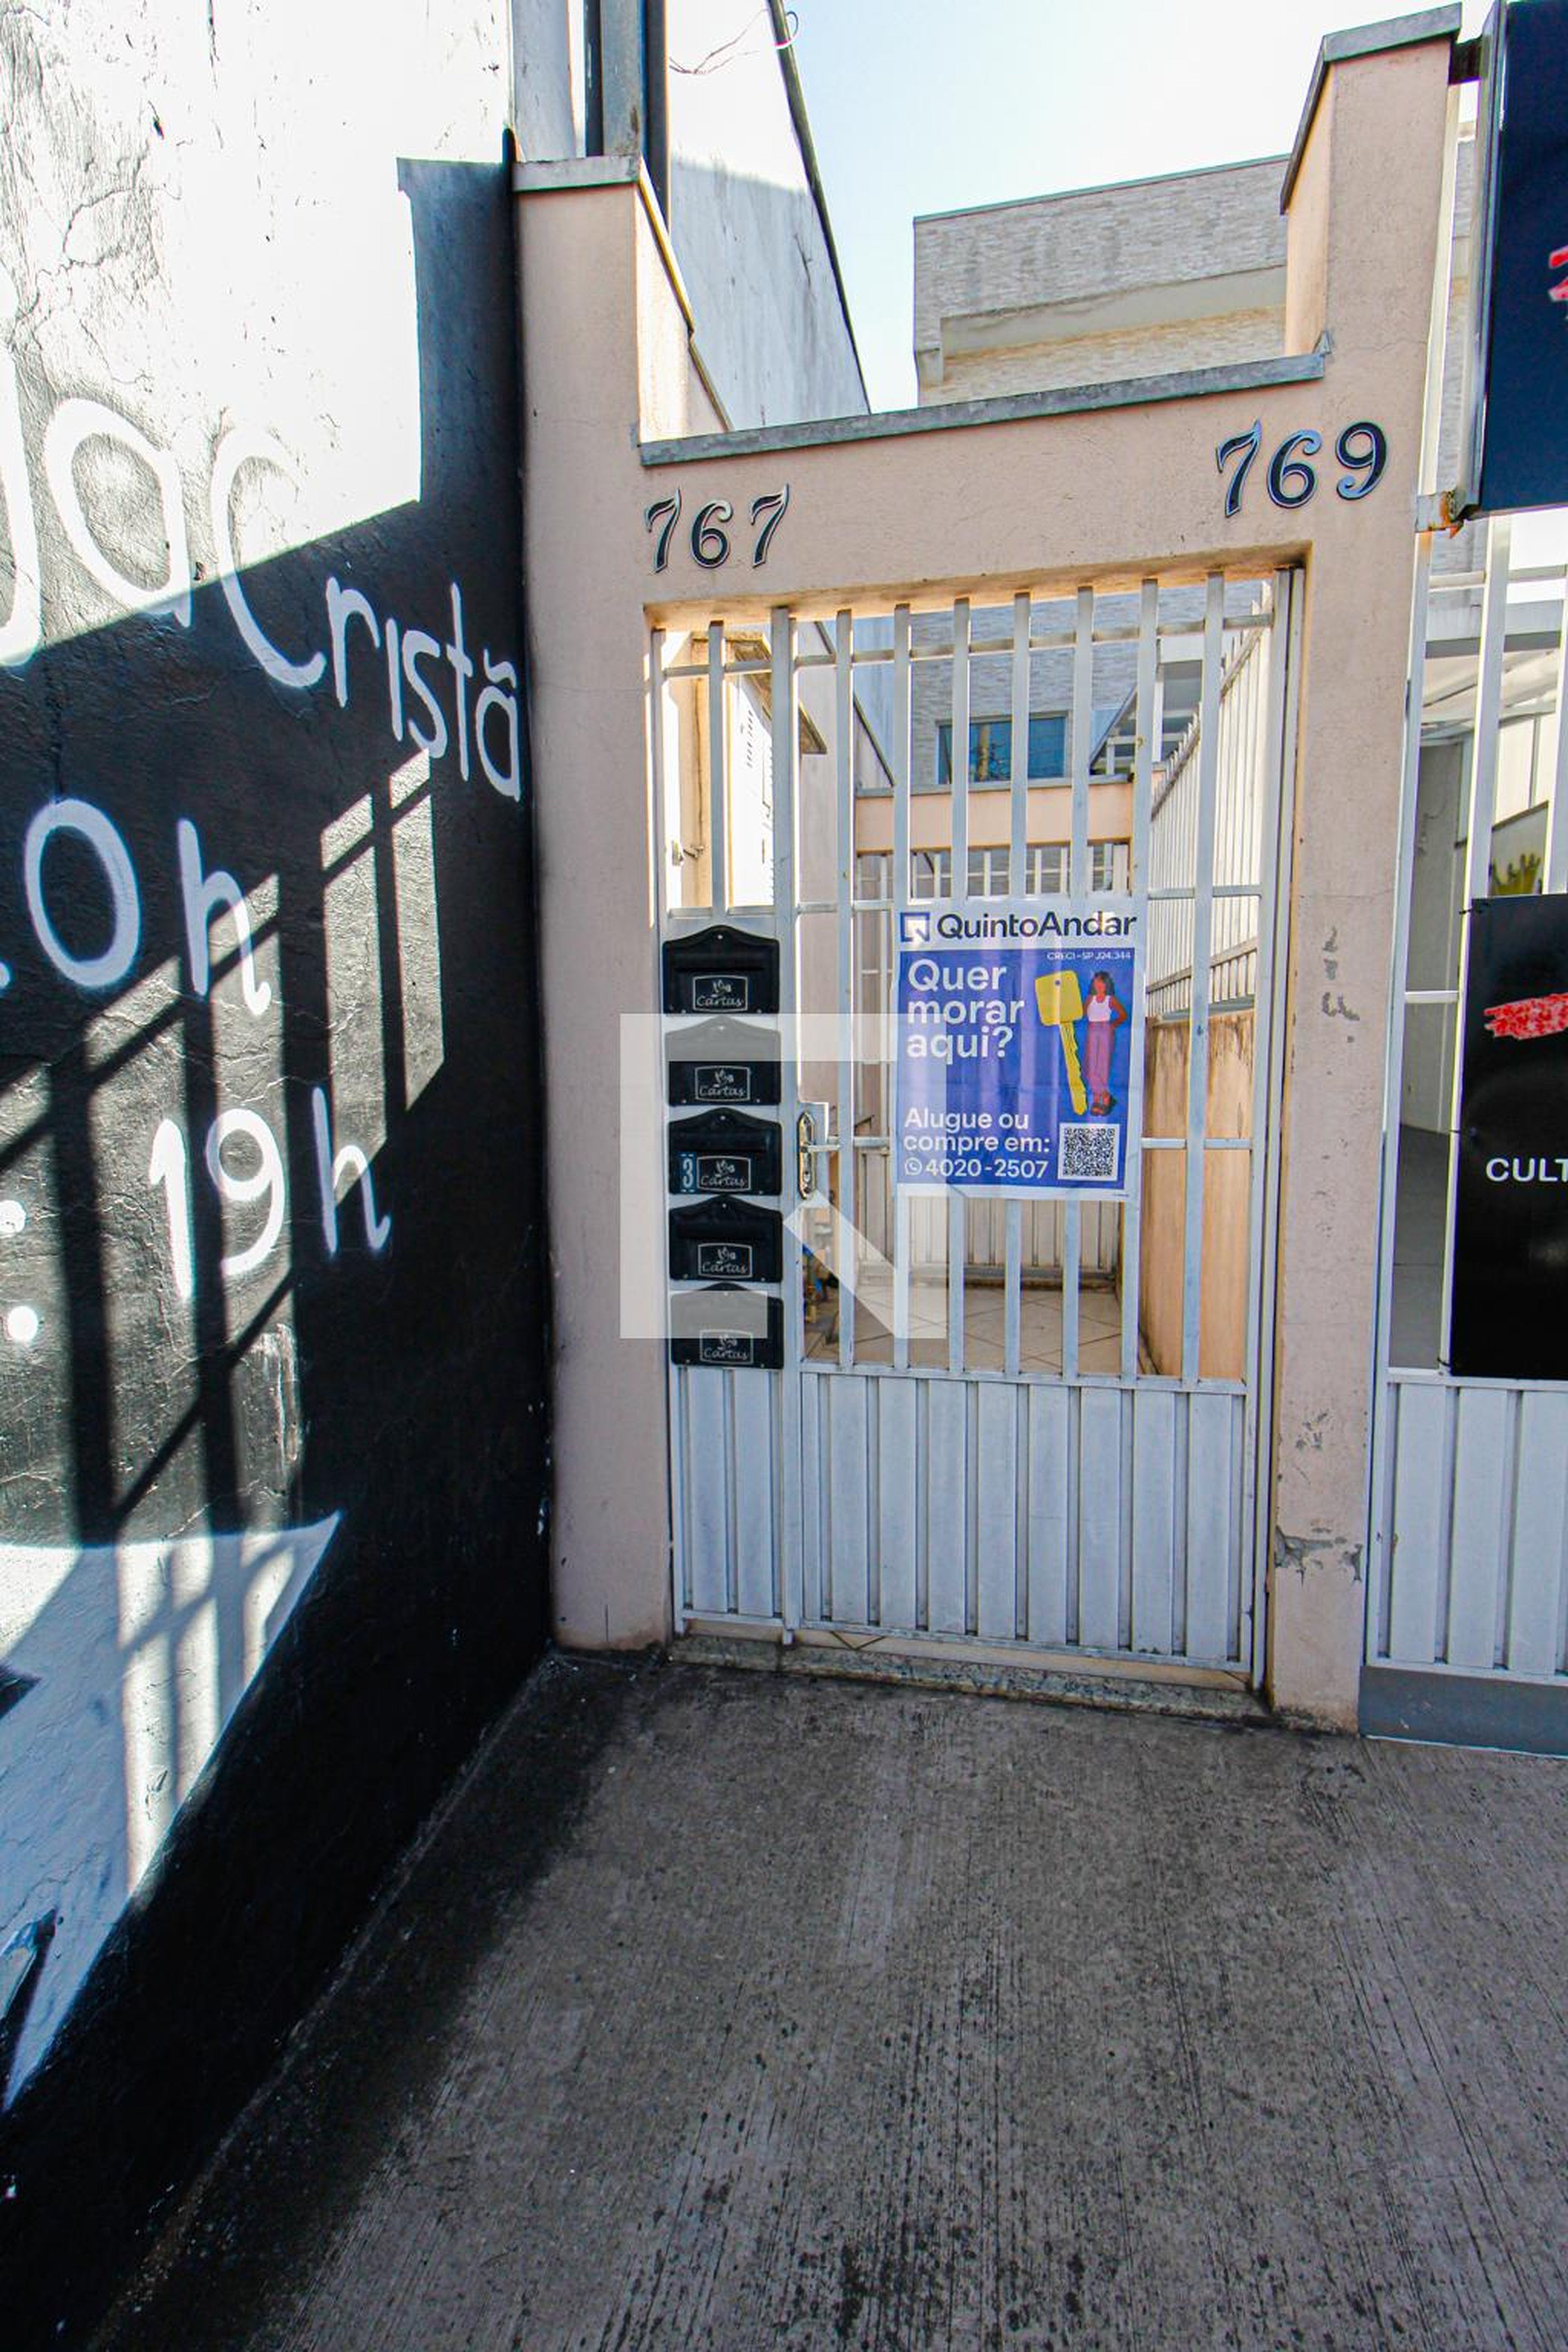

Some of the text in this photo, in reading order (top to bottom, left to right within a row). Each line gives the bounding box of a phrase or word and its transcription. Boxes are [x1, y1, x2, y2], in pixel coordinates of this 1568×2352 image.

[1216, 417, 1388, 518] 769
[644, 483, 789, 574] 767
[210, 425, 521, 802] Cristã
[937, 911, 1137, 939] QuintoAndar
[908, 959, 1007, 991] Quer
[908, 1000, 1025, 1024] morar
[906, 1025, 1013, 1065] aqui?
[904, 1107, 1029, 1132] Alugue ou
[904, 1135, 1050, 1155] compre em:
[682, 1157, 693, 1188] 3
[925, 1160, 1049, 1178] 4020-2507
[1486, 1157, 1568, 1182] CULT
[149, 1086, 392, 1303] 19h
